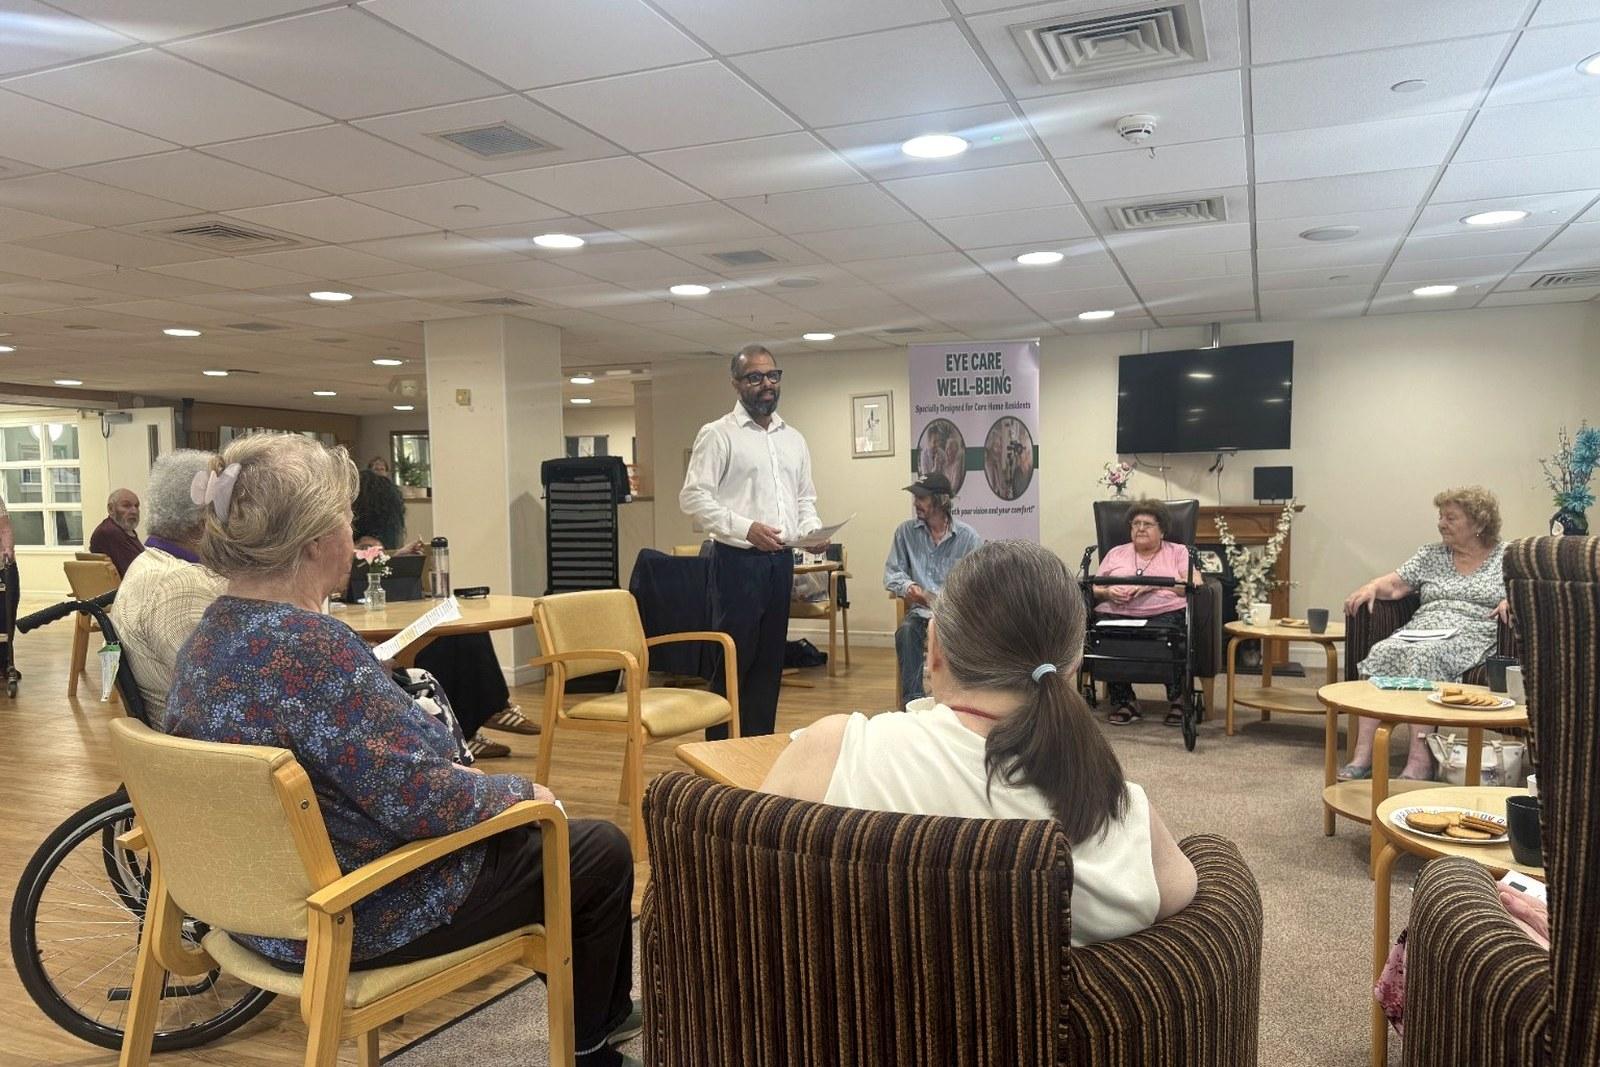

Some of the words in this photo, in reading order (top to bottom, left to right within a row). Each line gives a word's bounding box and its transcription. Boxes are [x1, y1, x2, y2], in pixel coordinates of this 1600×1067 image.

[946, 353, 968, 372] EYE
[937, 375, 1011, 396] WELL-BEING
[915, 403, 939, 415] Specially
[940, 402, 964, 414] Designed
[965, 402, 974, 411] for
[975, 402, 988, 411] Care
[989, 401, 1003, 411] Home
[1004, 400, 1031, 410] Residents
[961, 507, 972, 517] your
[973, 506, 988, 515] vision
[989, 506, 998, 514] and
[999, 507, 1010, 516] your
